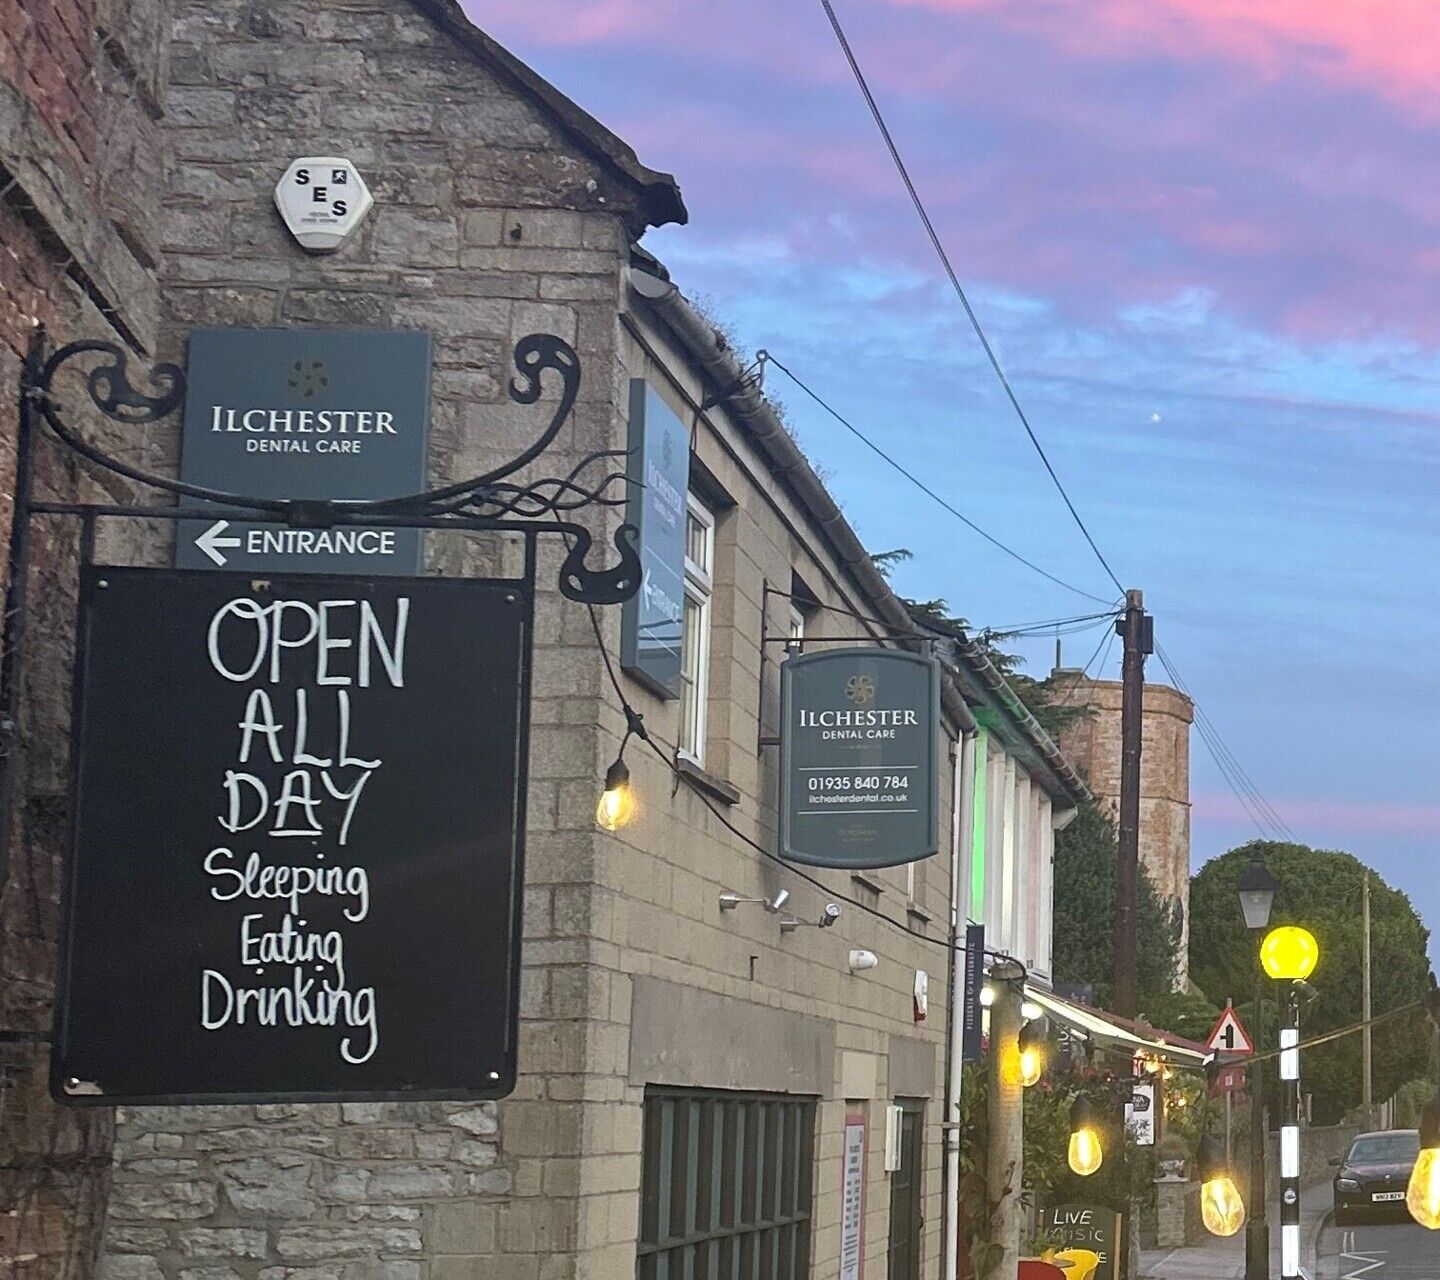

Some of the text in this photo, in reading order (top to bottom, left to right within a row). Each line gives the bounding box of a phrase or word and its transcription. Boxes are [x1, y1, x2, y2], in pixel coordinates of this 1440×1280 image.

[211, 405, 398, 434] ILCHESTER
[246, 439, 361, 454] DENTAL CARE
[247, 530, 396, 554] ENTRANCE
[207, 597, 410, 688] OPEN
[238, 688, 382, 770] ALL
[800, 709, 918, 727] ILCHESTER
[822, 729, 896, 740] DENTAL CARE
[808, 775, 908, 790] 01935 840 784
[218, 769, 373, 845] DAY
[204, 848, 370, 921] Sleeping
[241, 914, 345, 996] Eating
[201, 965, 377, 1064] Drinking
[1053, 1208, 1094, 1225] LIVE
